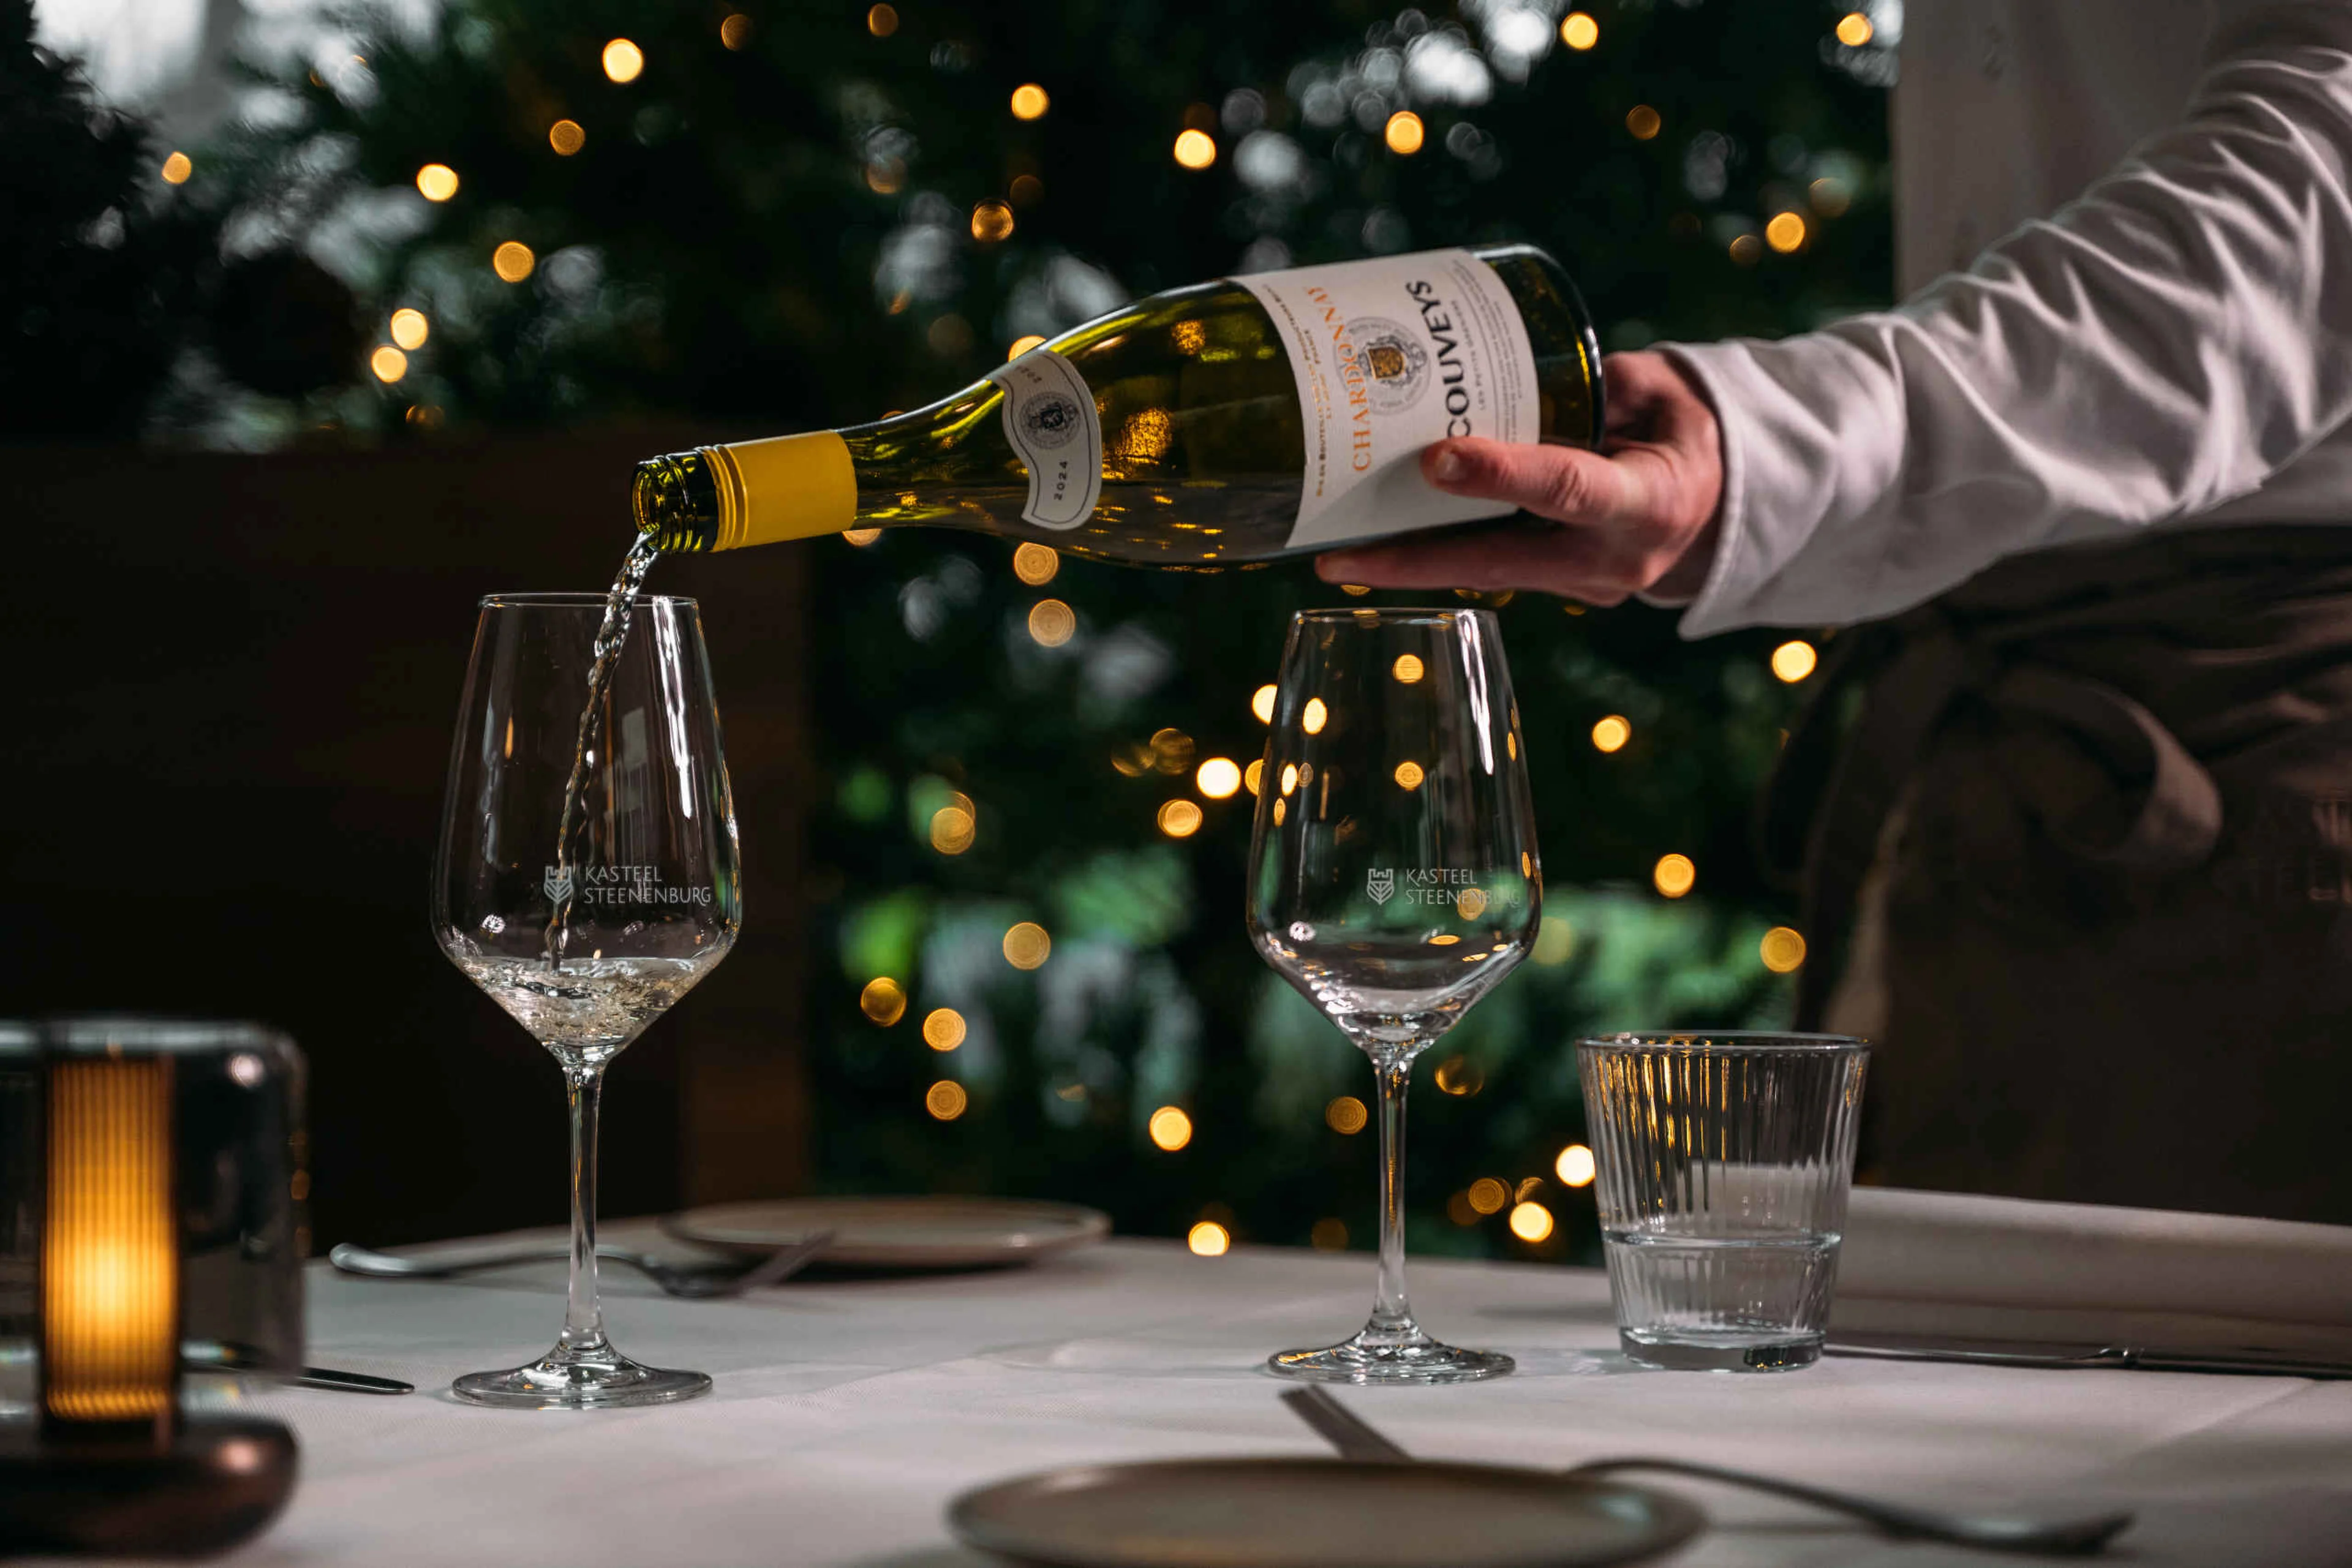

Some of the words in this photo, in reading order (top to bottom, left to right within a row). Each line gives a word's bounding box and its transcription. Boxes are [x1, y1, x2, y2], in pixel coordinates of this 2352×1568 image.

[1406, 281, 1471, 439] COUVEYS
[1305, 286, 1371, 472] CHARDONNAY
[1054, 461, 1068, 501] 2024
[585, 865, 662, 885] KASTEEL
[1406, 868, 1477, 887] KASTEEL
[584, 886, 711, 907] STEENENBURG
